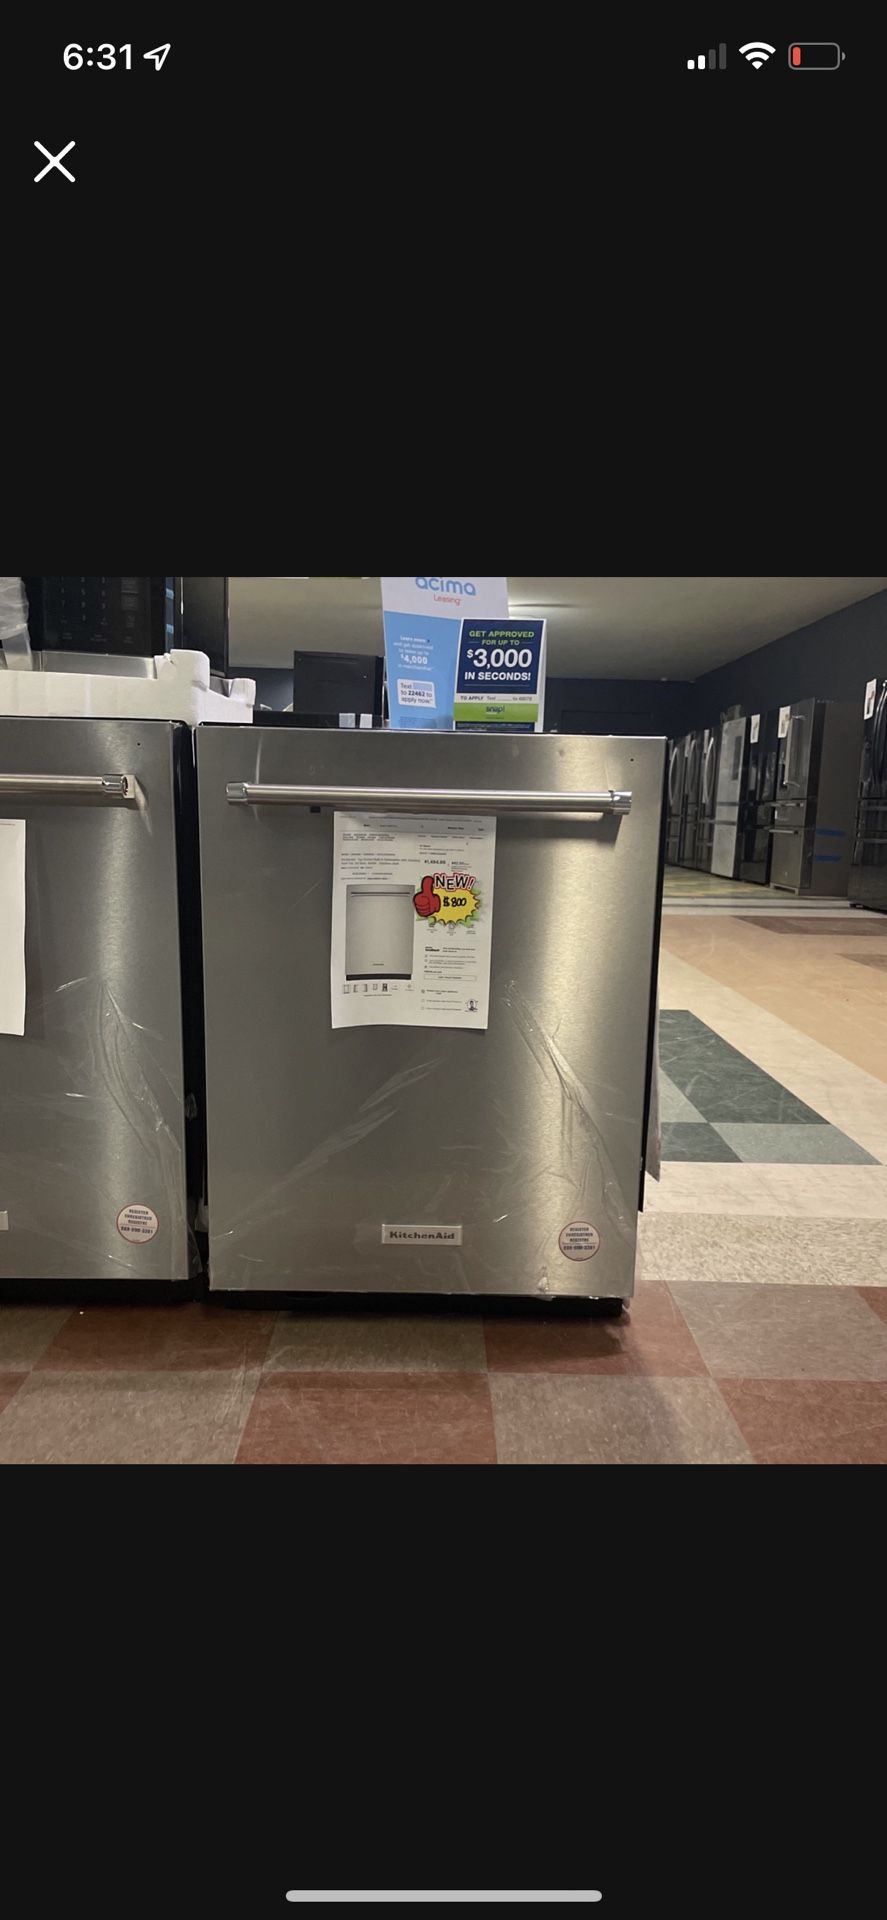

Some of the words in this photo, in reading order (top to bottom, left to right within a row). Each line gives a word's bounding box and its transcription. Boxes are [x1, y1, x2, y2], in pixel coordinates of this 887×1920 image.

[415, 577, 476, 596] acima
[433, 594, 461, 606] Leasing
[469, 630, 487, 638] GET
[466, 648, 532, 669] $3,000
[464, 672, 476, 680] IN
[477, 672, 531, 681] SECONDS!
[435, 874, 474, 890] NEW!
[389, 1231, 455, 1240] KitchenAid
